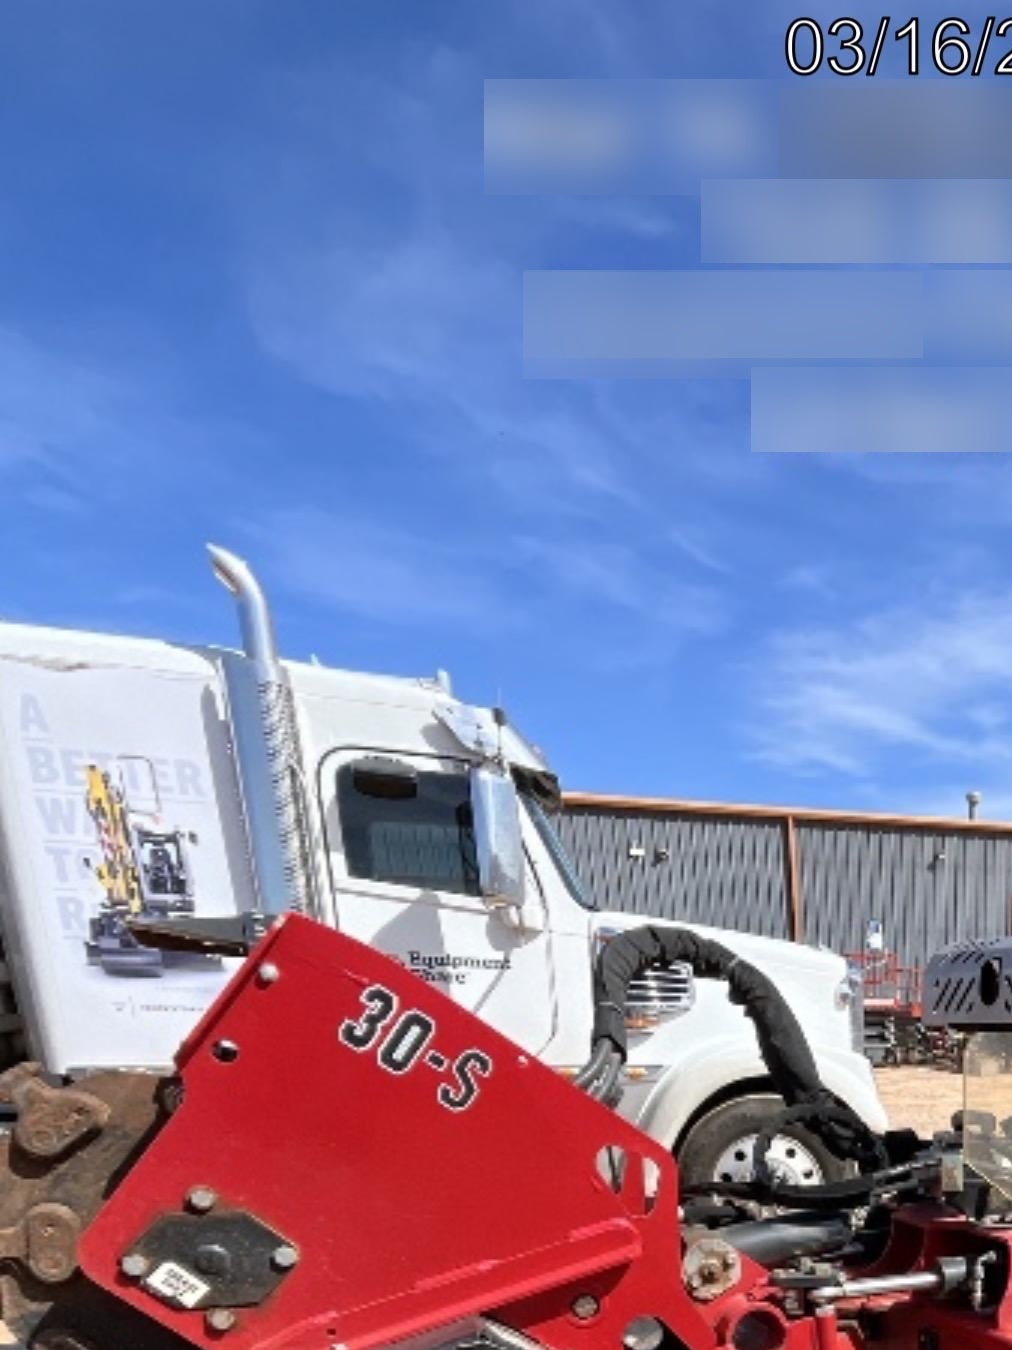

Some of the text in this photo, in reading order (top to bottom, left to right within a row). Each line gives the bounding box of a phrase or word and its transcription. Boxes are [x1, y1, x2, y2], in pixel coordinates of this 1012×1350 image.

[20, 693, 49, 732] A
[408, 950, 511, 969] Equipment
[338, 984, 492, 1112] 30-S
